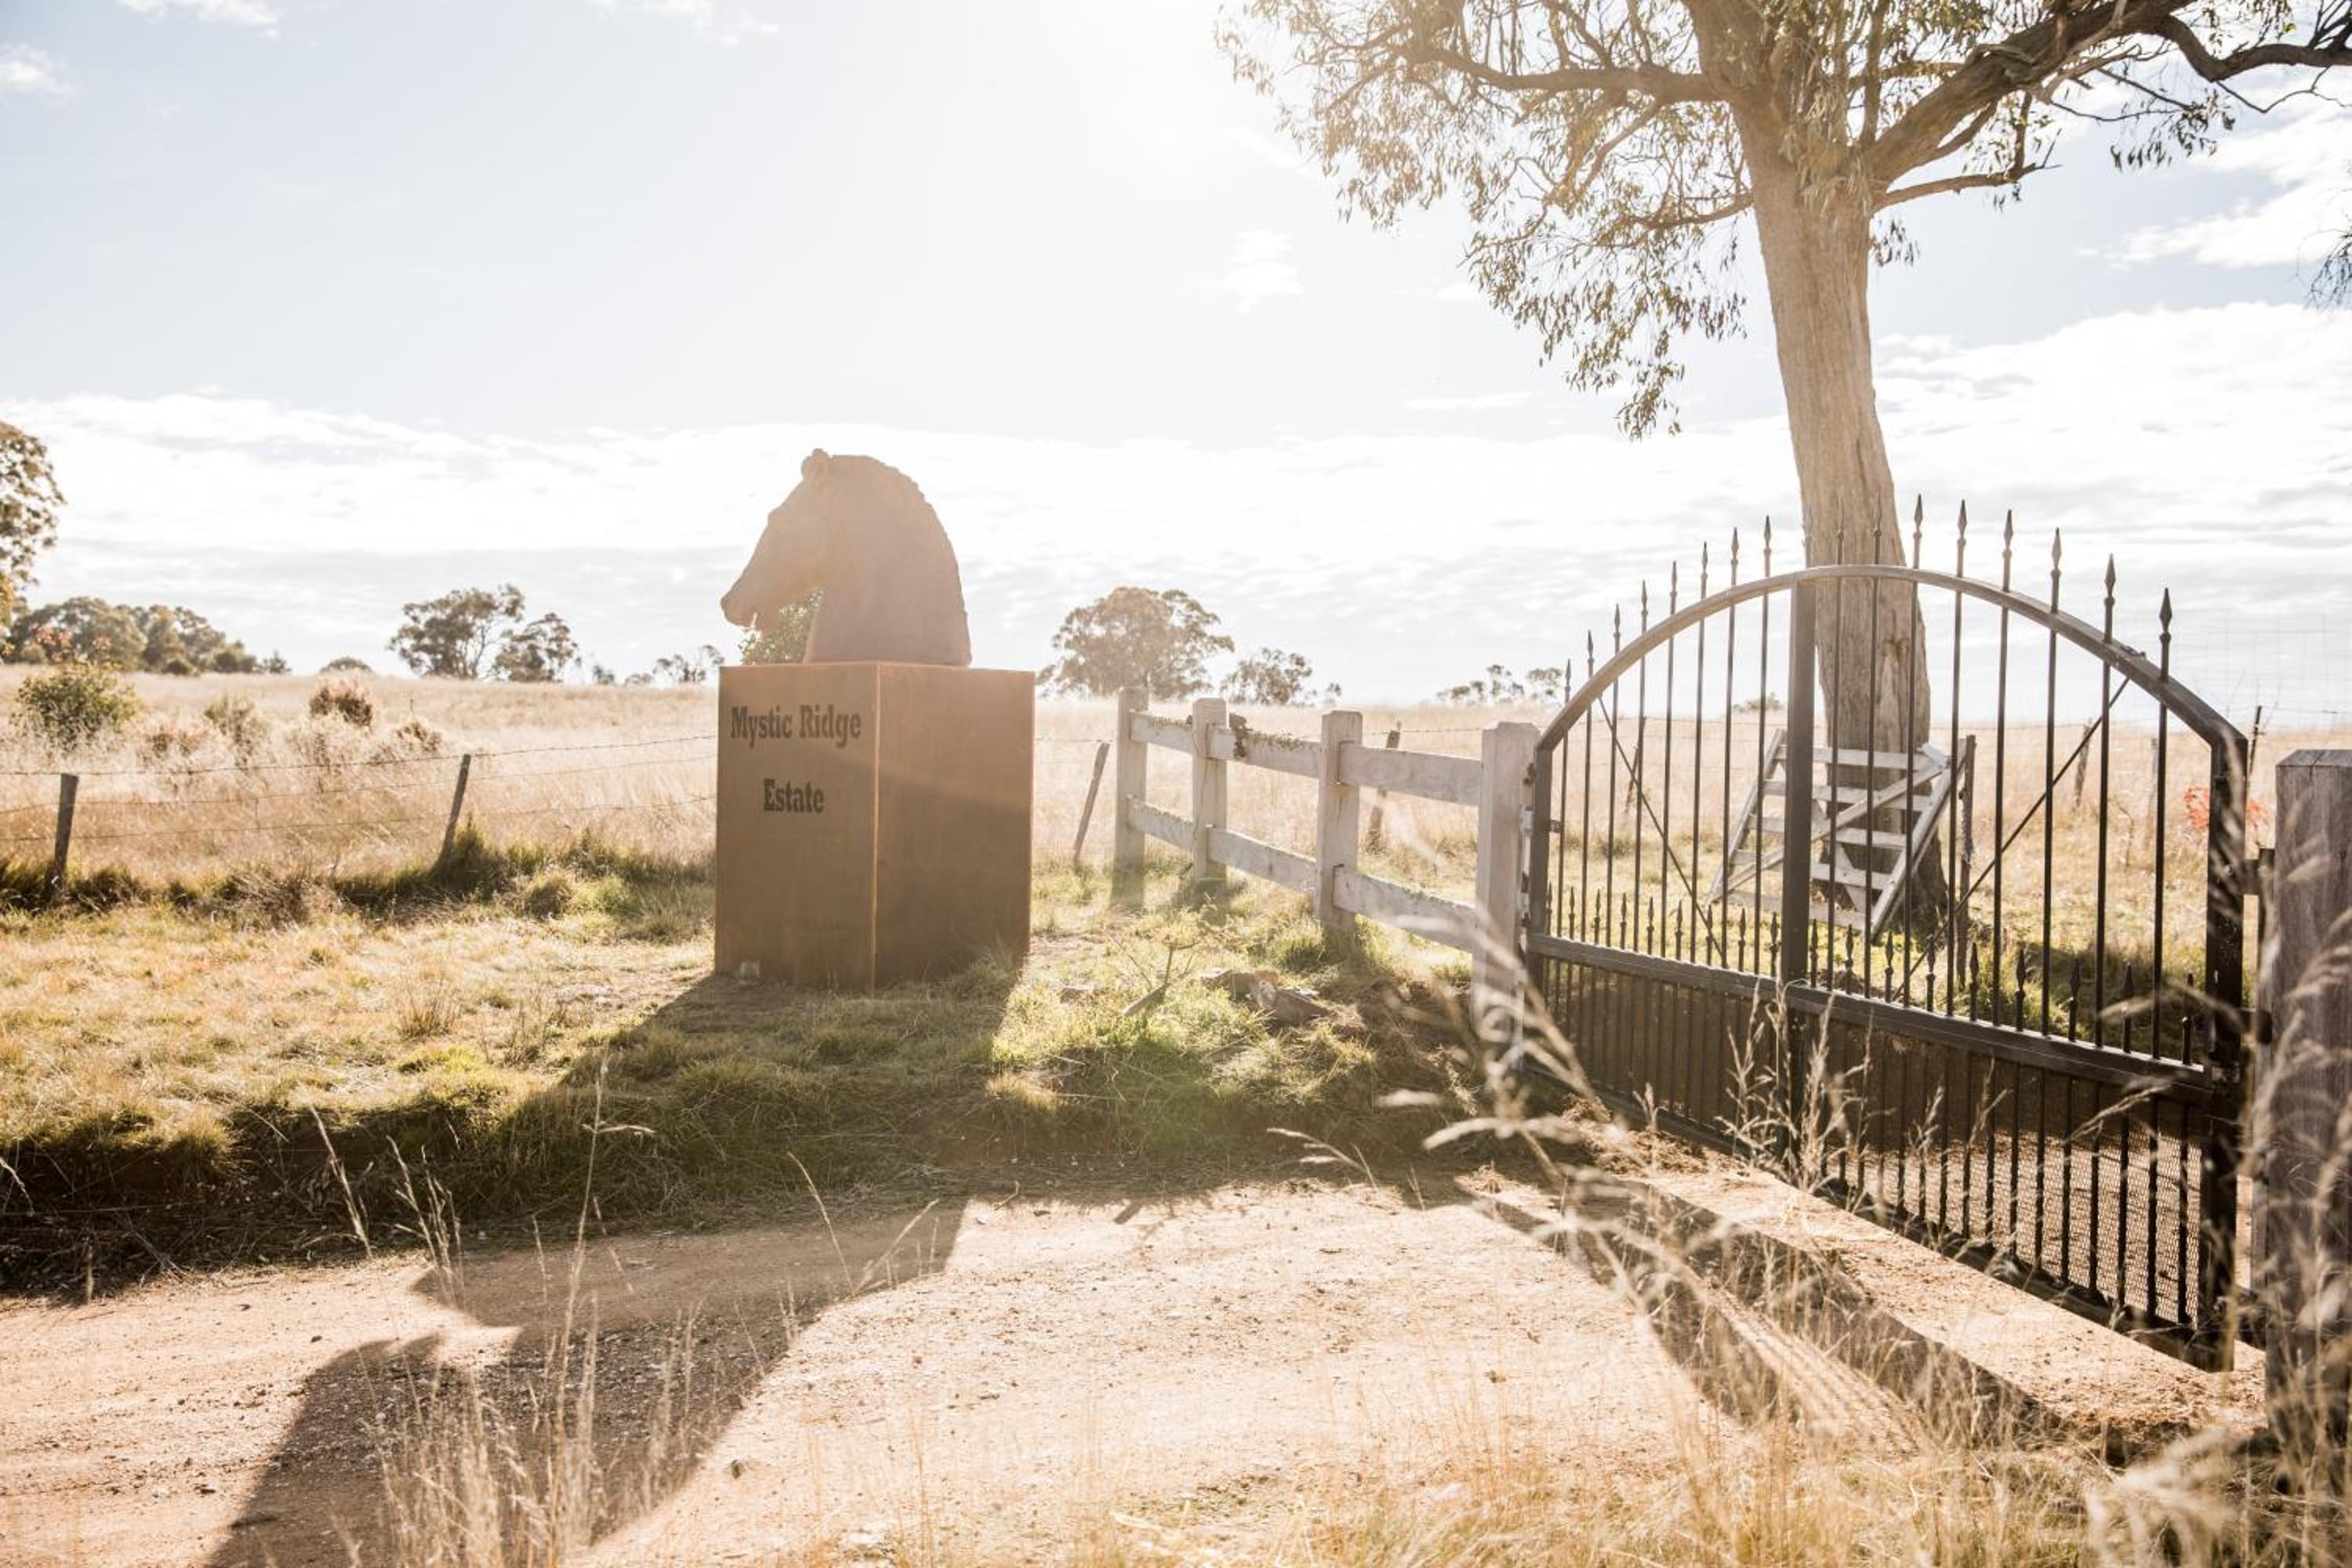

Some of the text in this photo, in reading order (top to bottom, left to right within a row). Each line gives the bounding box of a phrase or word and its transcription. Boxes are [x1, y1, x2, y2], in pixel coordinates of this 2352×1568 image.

[731, 703, 862, 749] Mystic Ridge
[763, 778, 824, 813] Estate
